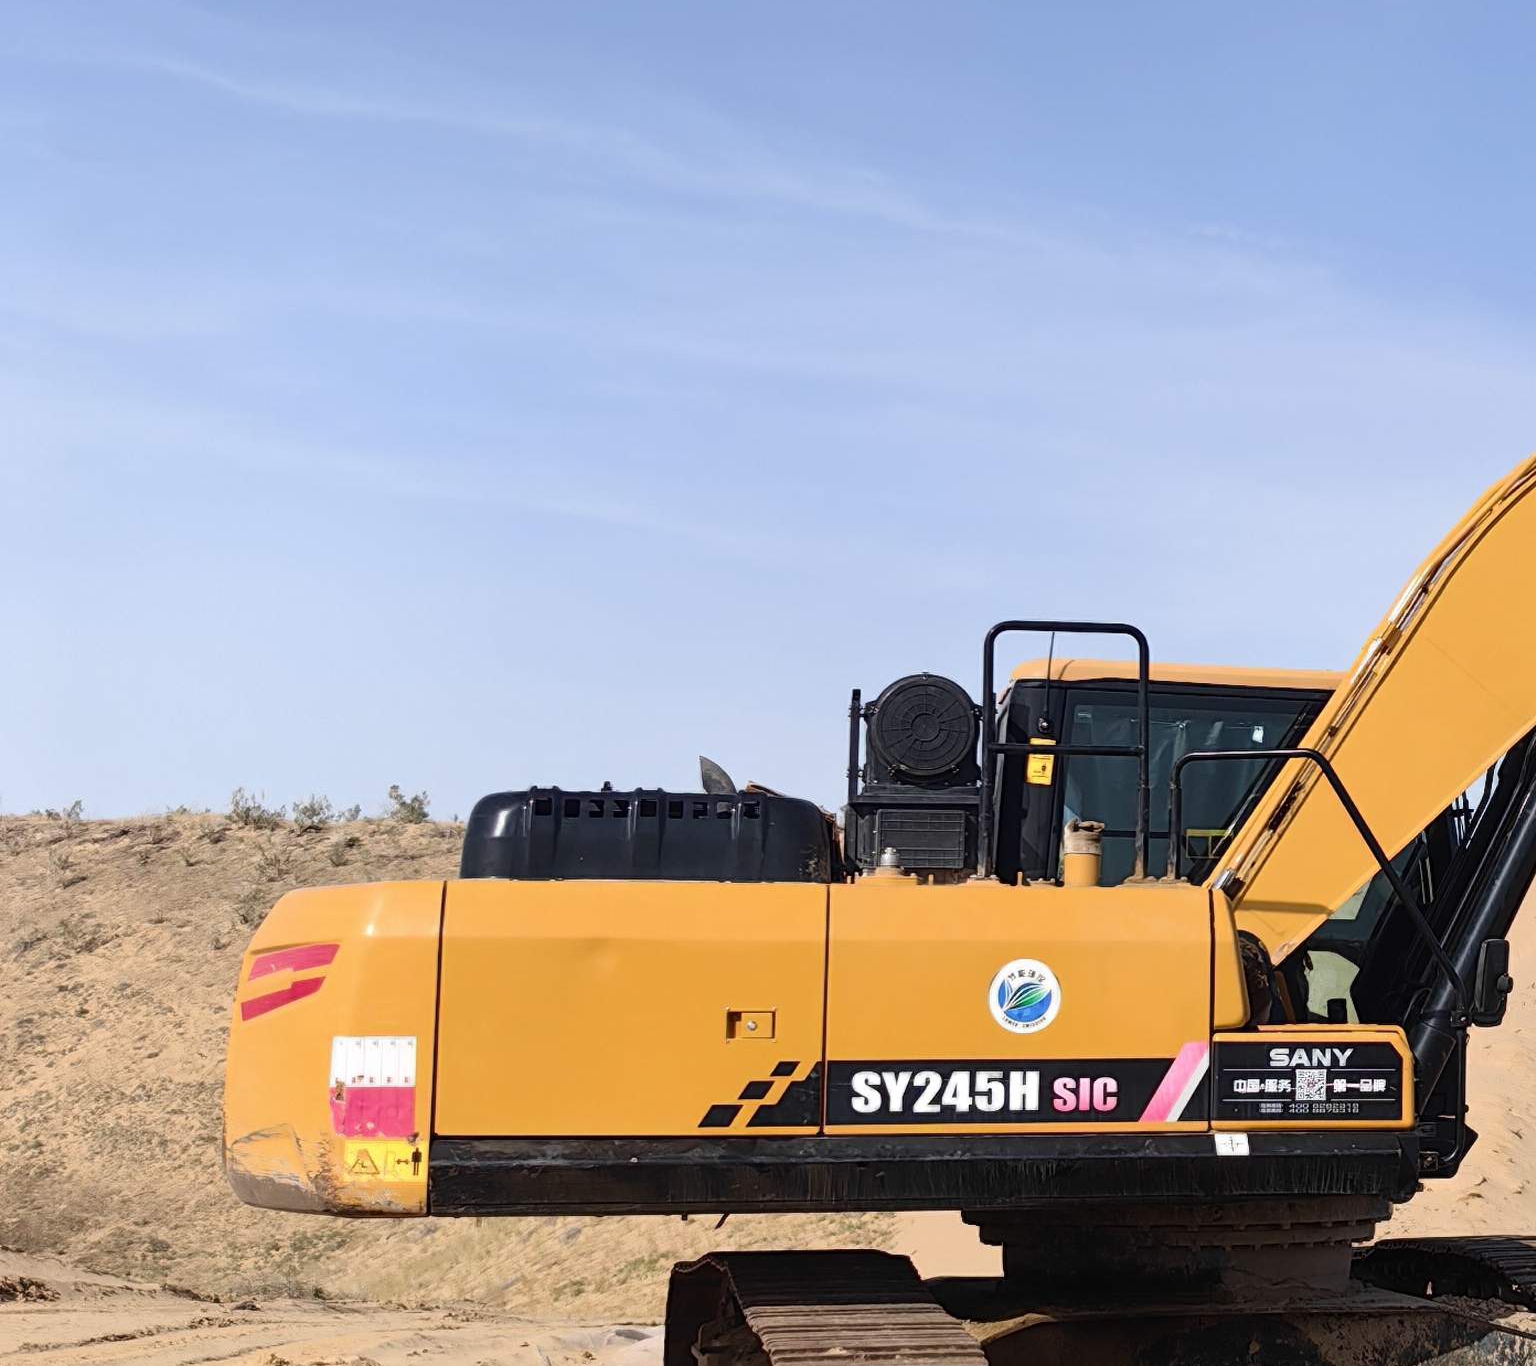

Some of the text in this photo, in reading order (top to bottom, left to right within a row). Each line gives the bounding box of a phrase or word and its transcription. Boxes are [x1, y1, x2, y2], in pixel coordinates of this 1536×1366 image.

[1269, 1048, 1354, 1067] SANY
[851, 1070, 1119, 1113] SY245H SIC
